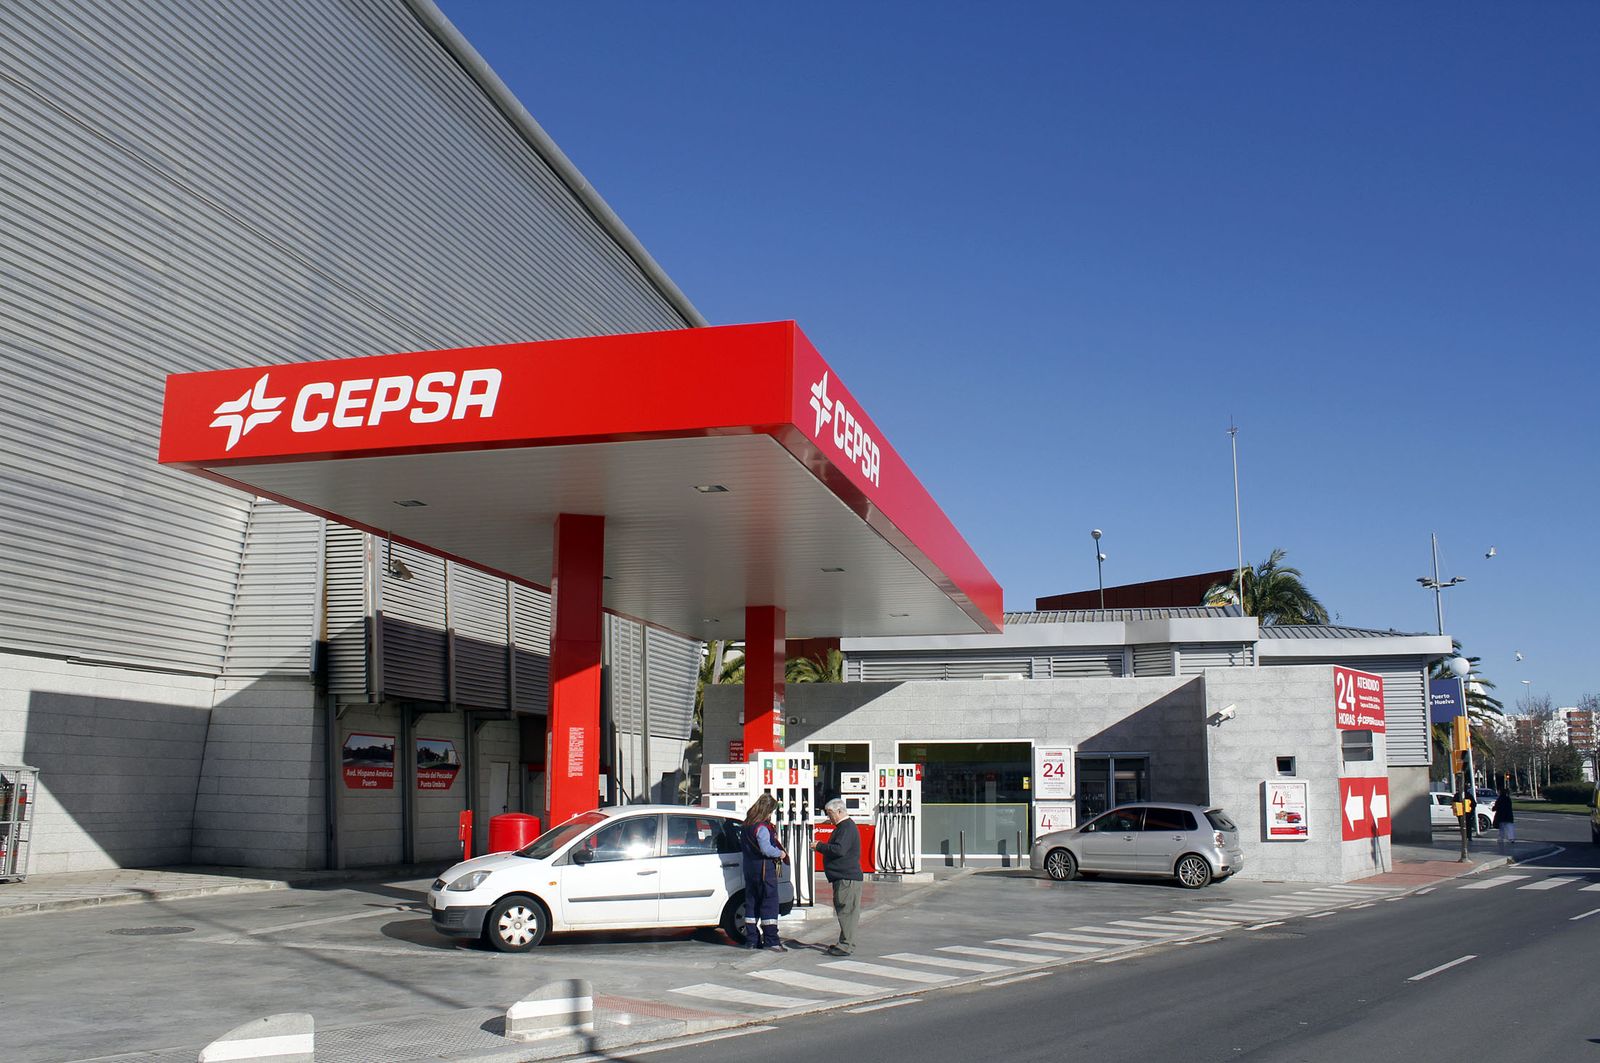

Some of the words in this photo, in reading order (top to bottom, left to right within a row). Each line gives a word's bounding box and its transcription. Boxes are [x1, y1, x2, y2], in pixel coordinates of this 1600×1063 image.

[291, 368, 502, 432] CEPSA
[834, 400, 880, 488] CEPSA
[1336, 672, 1356, 711] 24
[1357, 676, 1380, 692] ATENDIDO
[1338, 712, 1356, 726] HORAS
[357, 768, 375, 778] Hispano
[375, 769, 393, 777] América
[1043, 763, 1065, 778] 24
[362, 779, 378, 787] Puerto
[420, 780, 431, 788] Punta
